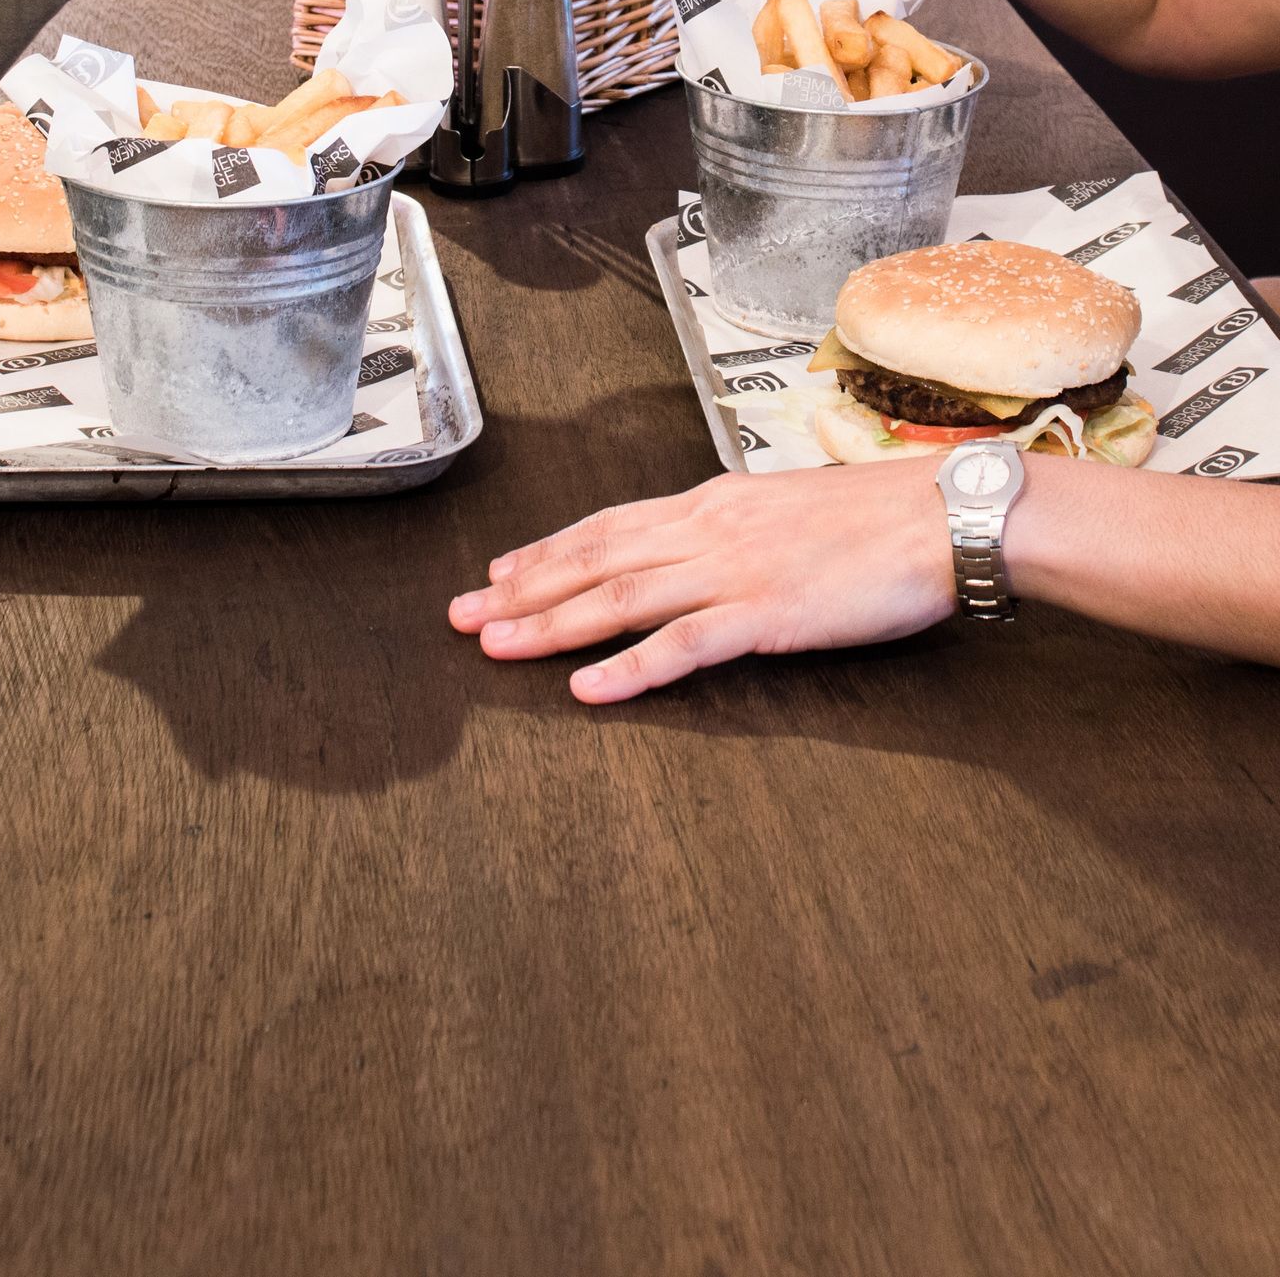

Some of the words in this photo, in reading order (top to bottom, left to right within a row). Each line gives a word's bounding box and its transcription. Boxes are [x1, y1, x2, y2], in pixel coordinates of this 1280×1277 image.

[1184, 272, 1231, 304] ALMERS
[358, 346, 410, 372] ALMERS
[1163, 397, 1221, 439] PALMERS
[1164, 395, 1215, 425] LODGE
